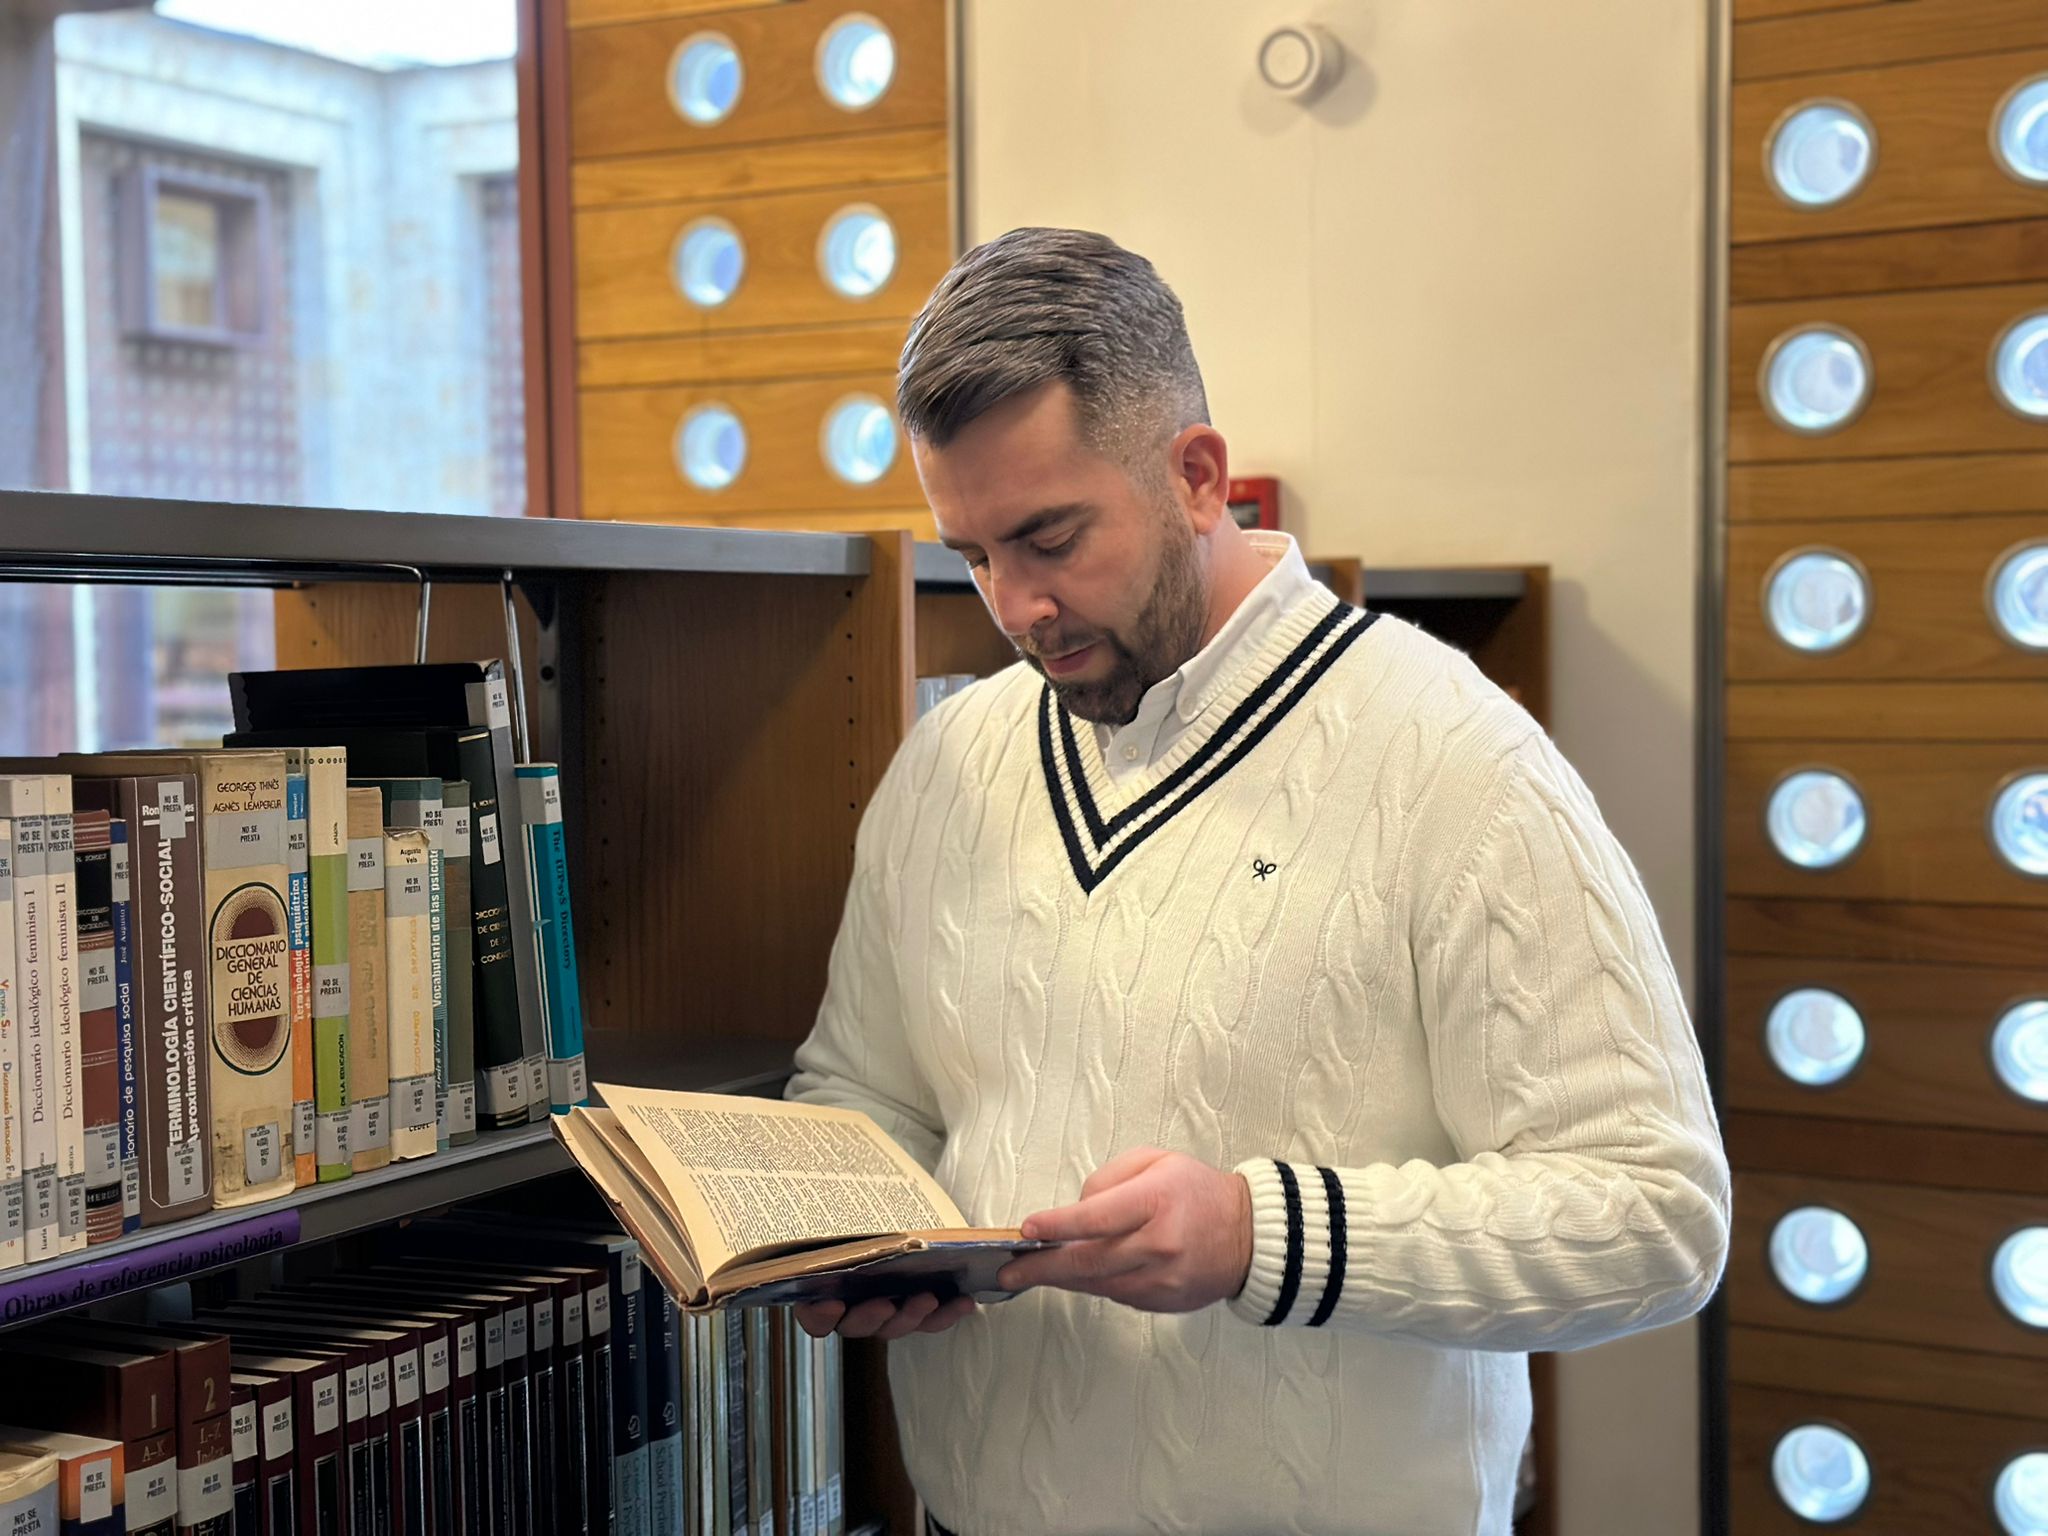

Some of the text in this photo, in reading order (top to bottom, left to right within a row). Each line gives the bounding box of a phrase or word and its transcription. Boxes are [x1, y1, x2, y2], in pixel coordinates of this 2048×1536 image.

[217, 782, 256, 793] GEORGES
[164, 795, 178, 803] NO SE
[249, 792, 255, 800] Y
[163, 804, 181, 813] PRESTA
[213, 801, 240, 812] AGNÈS
[244, 800, 282, 810] LEMPEREUR
[434, 810, 442, 818] SE
[51, 829, 70, 839] NO SE
[251, 825, 258, 833] SE
[482, 828, 489, 836] NO
[21, 831, 40, 841] NO SE
[240, 834, 260, 843] PRESTA
[18, 843, 44, 853] PRESTA
[48, 841, 73, 852] PRESTA
[289, 842, 305, 850] PRESTA
[400, 848, 421, 856] Augusto
[117, 862, 123, 870] NO
[358, 860, 375, 868] PRESTA
[115, 870, 129, 879] PRES
[405, 885, 421, 894] PRESTA
[430, 893, 440, 913] las
[291, 879, 303, 946] psiquiátrica
[158, 838, 178, 1012] CIENTÍFICO-SOCIAL
[430, 916, 440, 931] de
[26, 902, 38, 963] feminista
[560, 912, 572, 969] Directory
[216, 939, 287, 961] DICCIONARIO
[227, 956, 279, 973] GENERAL
[89, 966, 105, 976] NO SE
[432, 935, 442, 1008] Vocabulario
[87, 976, 109, 986] PRESTA
[247, 971, 263, 984] DE
[322, 978, 339, 987] NO SE
[231, 983, 278, 1002] CIENCIAS
[320, 987, 342, 996] PRESTA
[28, 969, 41, 1038] ideológico
[56, 883, 74, 1119] Diccionario ideológico feminista II
[119, 982, 131, 1020] social
[182, 970, 194, 1026] crítica
[228, 997, 282, 1017] HUMANAS
[122, 1024, 134, 1081] pesquisa
[31, 1044, 43, 1123] Diccionario
[340, 1083, 346, 1095] LA
[123, 1087, 134, 1104] de
[340, 1097, 346, 1107] DE
[4, 1289, 67, 1321] Obras
[72, 1279, 96, 1299] de
[100, 1256, 194, 1297] referencia
[204, 1377, 216, 1413] 2
[151, 1394, 157, 1429] 1
[86, 1472, 103, 1482] NO SE
[84, 1482, 106, 1494] PRESTA
[14, 1508, 38, 1525] NO SE
[12, 1519, 42, 1536] PRESTA
